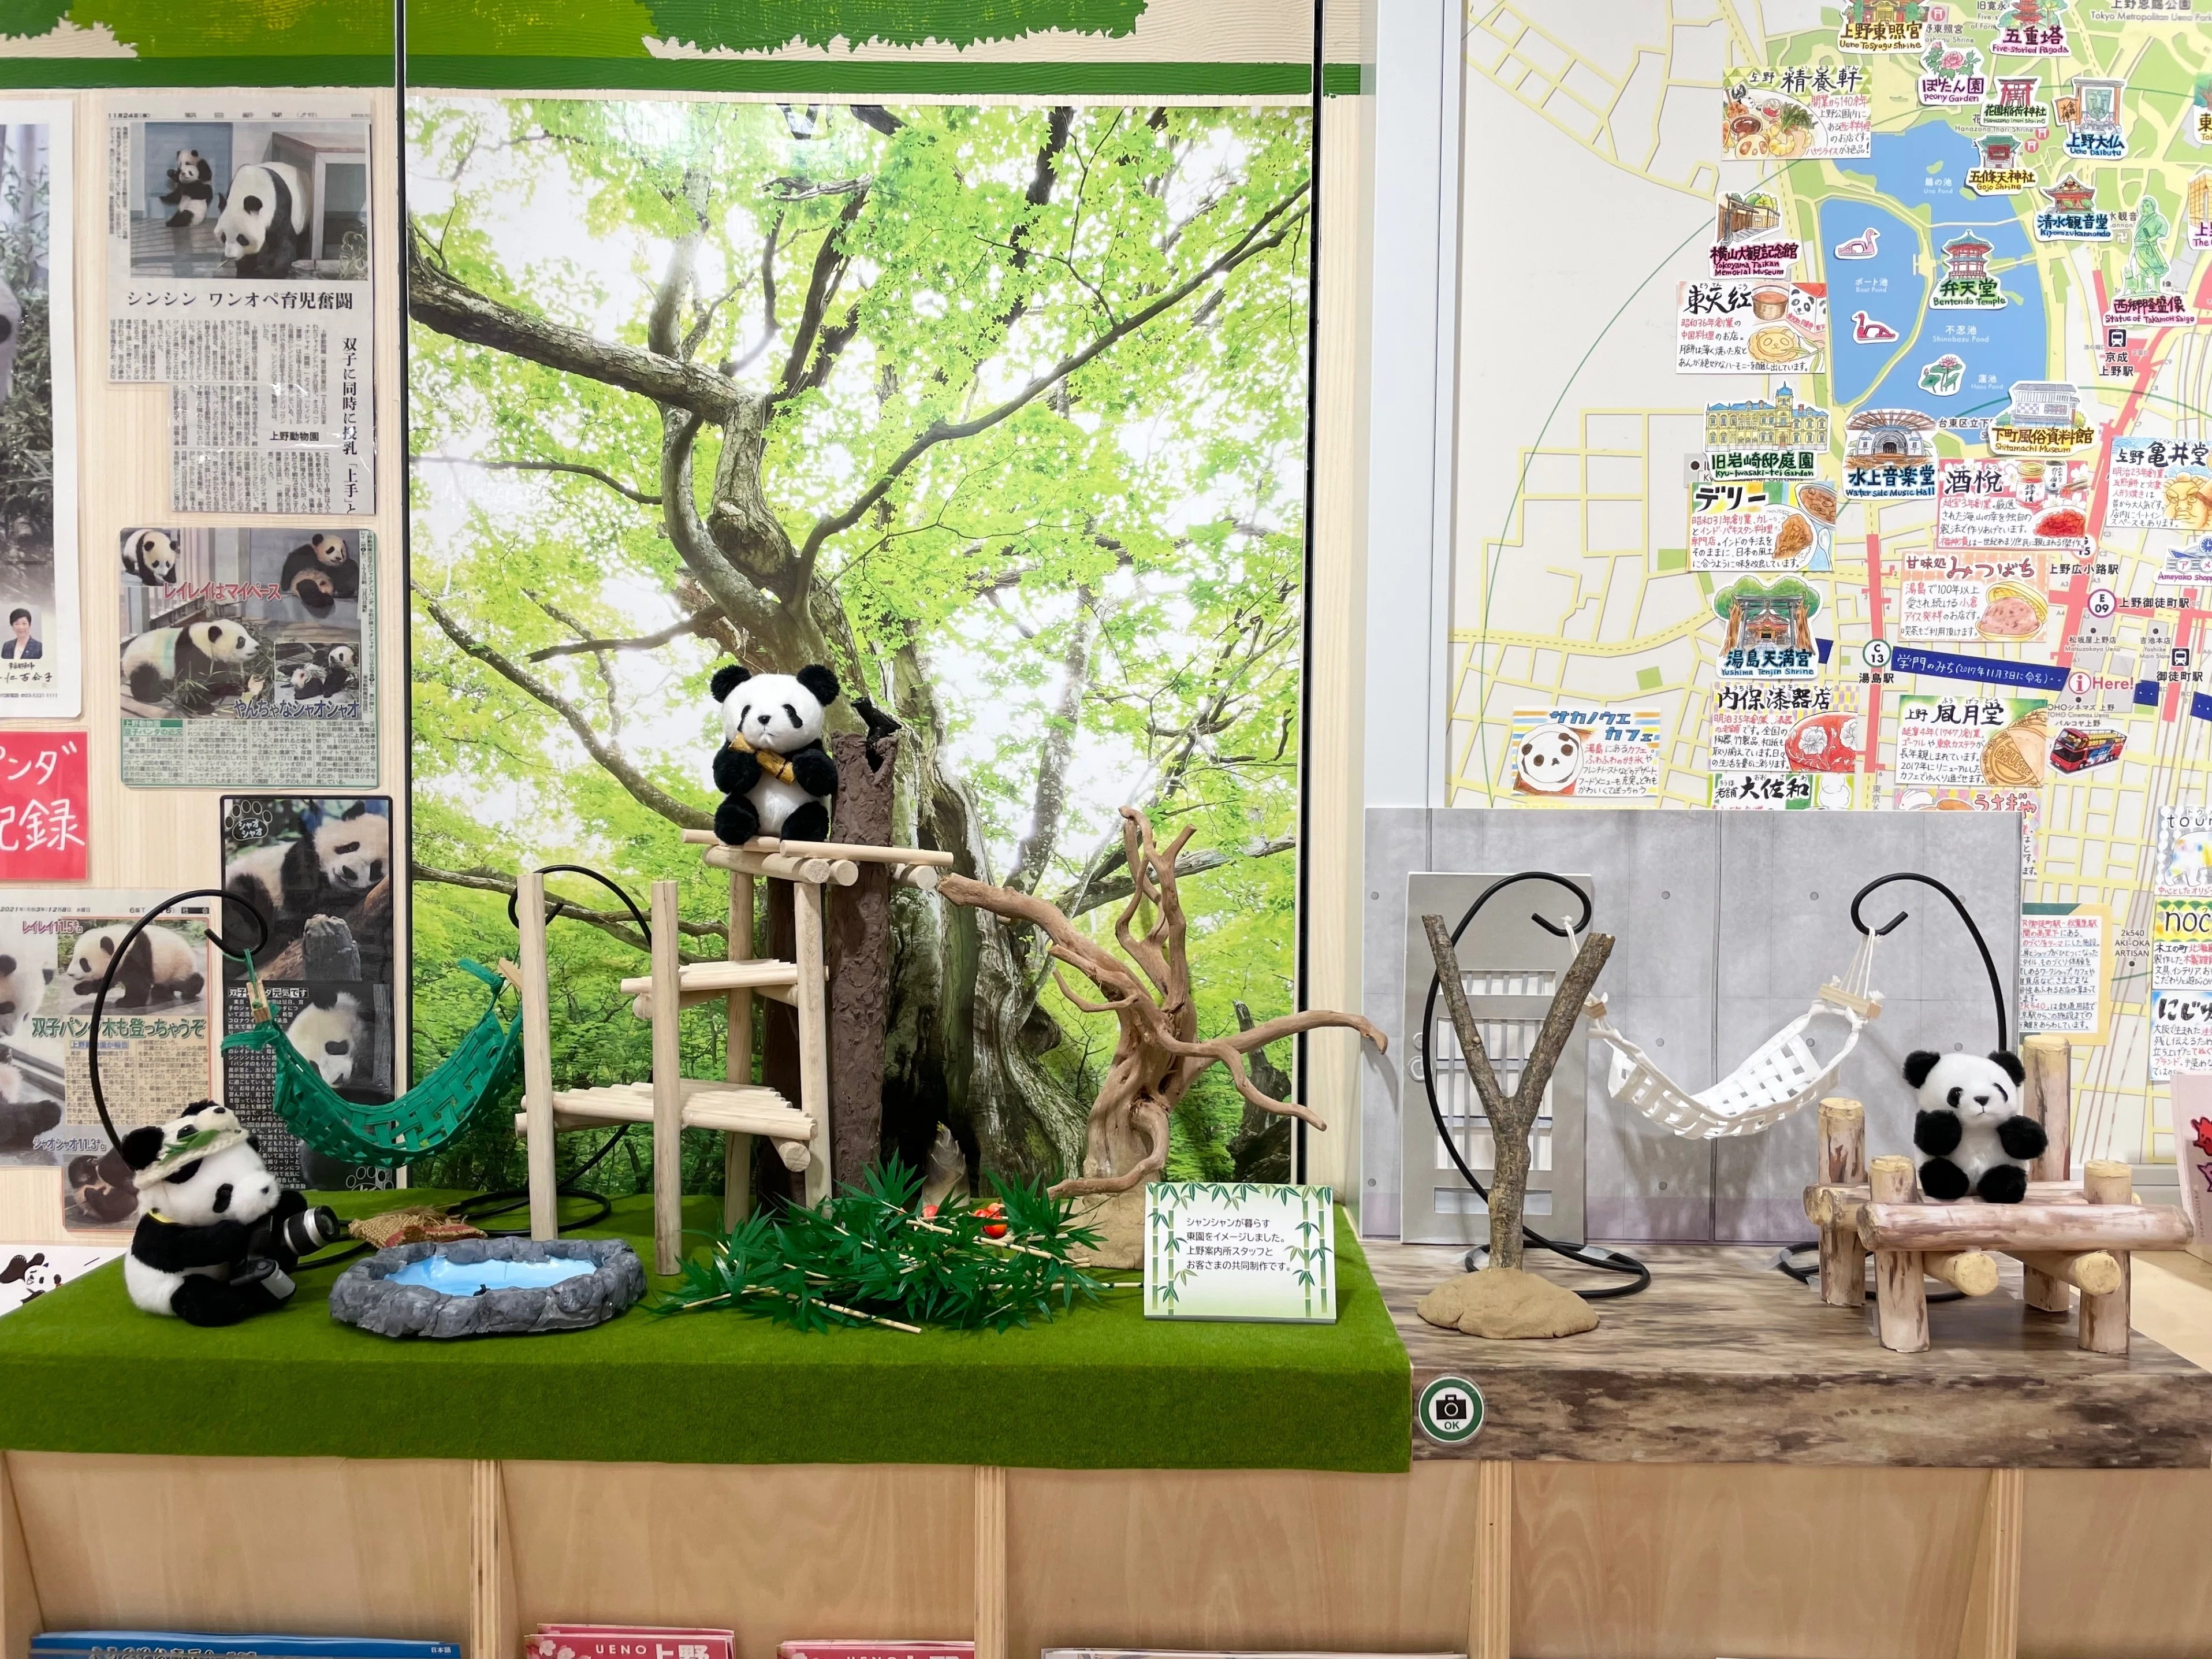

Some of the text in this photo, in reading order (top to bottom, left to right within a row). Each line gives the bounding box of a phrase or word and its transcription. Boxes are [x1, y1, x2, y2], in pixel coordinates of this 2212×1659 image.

[2091, 11, 2115, 21] Tokyo
[2118, 12, 2169, 22] Metropolitan
[1841, 21, 1922, 40] 上野東照宮
[2003, 25, 2063, 45] 五重塔
[1781, 69, 1863, 93] 精養軒
[1819, 109, 1867, 118] 上野公園内に
[1830, 132, 1870, 143] のお店です。
[2066, 133, 2125, 150] 上野大仏
[1976, 184, 1993, 192] Gojo
[2038, 214, 2109, 230] 清水観音堂
[1710, 242, 1799, 261] 横山大観記念館
[1855, 278, 1888, 286] ボート池
[1939, 278, 1997, 297] 弁天堂
[128, 291, 353, 310] シンシン ワンオペ育児奮闘
[1933, 297, 2006, 307] Bentendo Temple
[2114, 296, 2185, 314] 西郷隆盛像
[1945, 325, 1977, 334] 不忍池
[2105, 352, 2128, 363] 京成
[2099, 365, 2133, 377] 上野駅
[270, 431, 319, 441] 上野動物園
[1992, 427, 2094, 444] 下町風俗資料館
[1712, 452, 1814, 470] 旧岩崎邸庭園
[1784, 468, 1813, 477] Garden
[1848, 467, 1935, 486] 水上音楽堂
[1944, 470, 2002, 494] 酒悦
[1916, 488, 1935, 496] Hall
[1695, 486, 1766, 512] デリー
[1906, 556, 2034, 578] 甘味処 みつばち
[2050, 564, 2118, 575] 上野広小路駅
[163, 581, 281, 601] レイレイはマイペース
[2095, 604, 2109, 613] 09
[2119, 598, 2189, 608] 上野御徒町駅
[1874, 644, 1880, 652] C
[1725, 649, 1812, 668] 湯島天満宮
[1871, 654, 1883, 663] 13
[1859, 673, 1894, 684] 湯島駅
[2157, 671, 2203, 682] 御徒町駅
[2092, 676, 2134, 689] Here!
[1718, 687, 1831, 711] 内保漆器店
[233, 699, 360, 719] やんちゃなシャオシャオ
[1550, 711, 1630, 724] サカノウエ
[1606, 727, 1653, 742] カフェ
[0, 740, 77, 785] ンダ
[1975, 793, 2036, 819] うさぎや
[238, 819, 259, 830] シャオ
[243, 828, 263, 838] シャオ
[229, 988, 307, 998] 双子ダ元気です
[1186, 1217, 1270, 1228] シャンシャンが暮らす
[1186, 1232, 1285, 1243] 東園をイメージしました。
[1186, 1246, 1273, 1257] 上野案内所スタッフと
[1186, 1260, 1290, 1271] お客さまの共同制作です。
[1444, 1421, 1459, 1430] OK
[595, 1643, 709, 1659] UENO 上野
